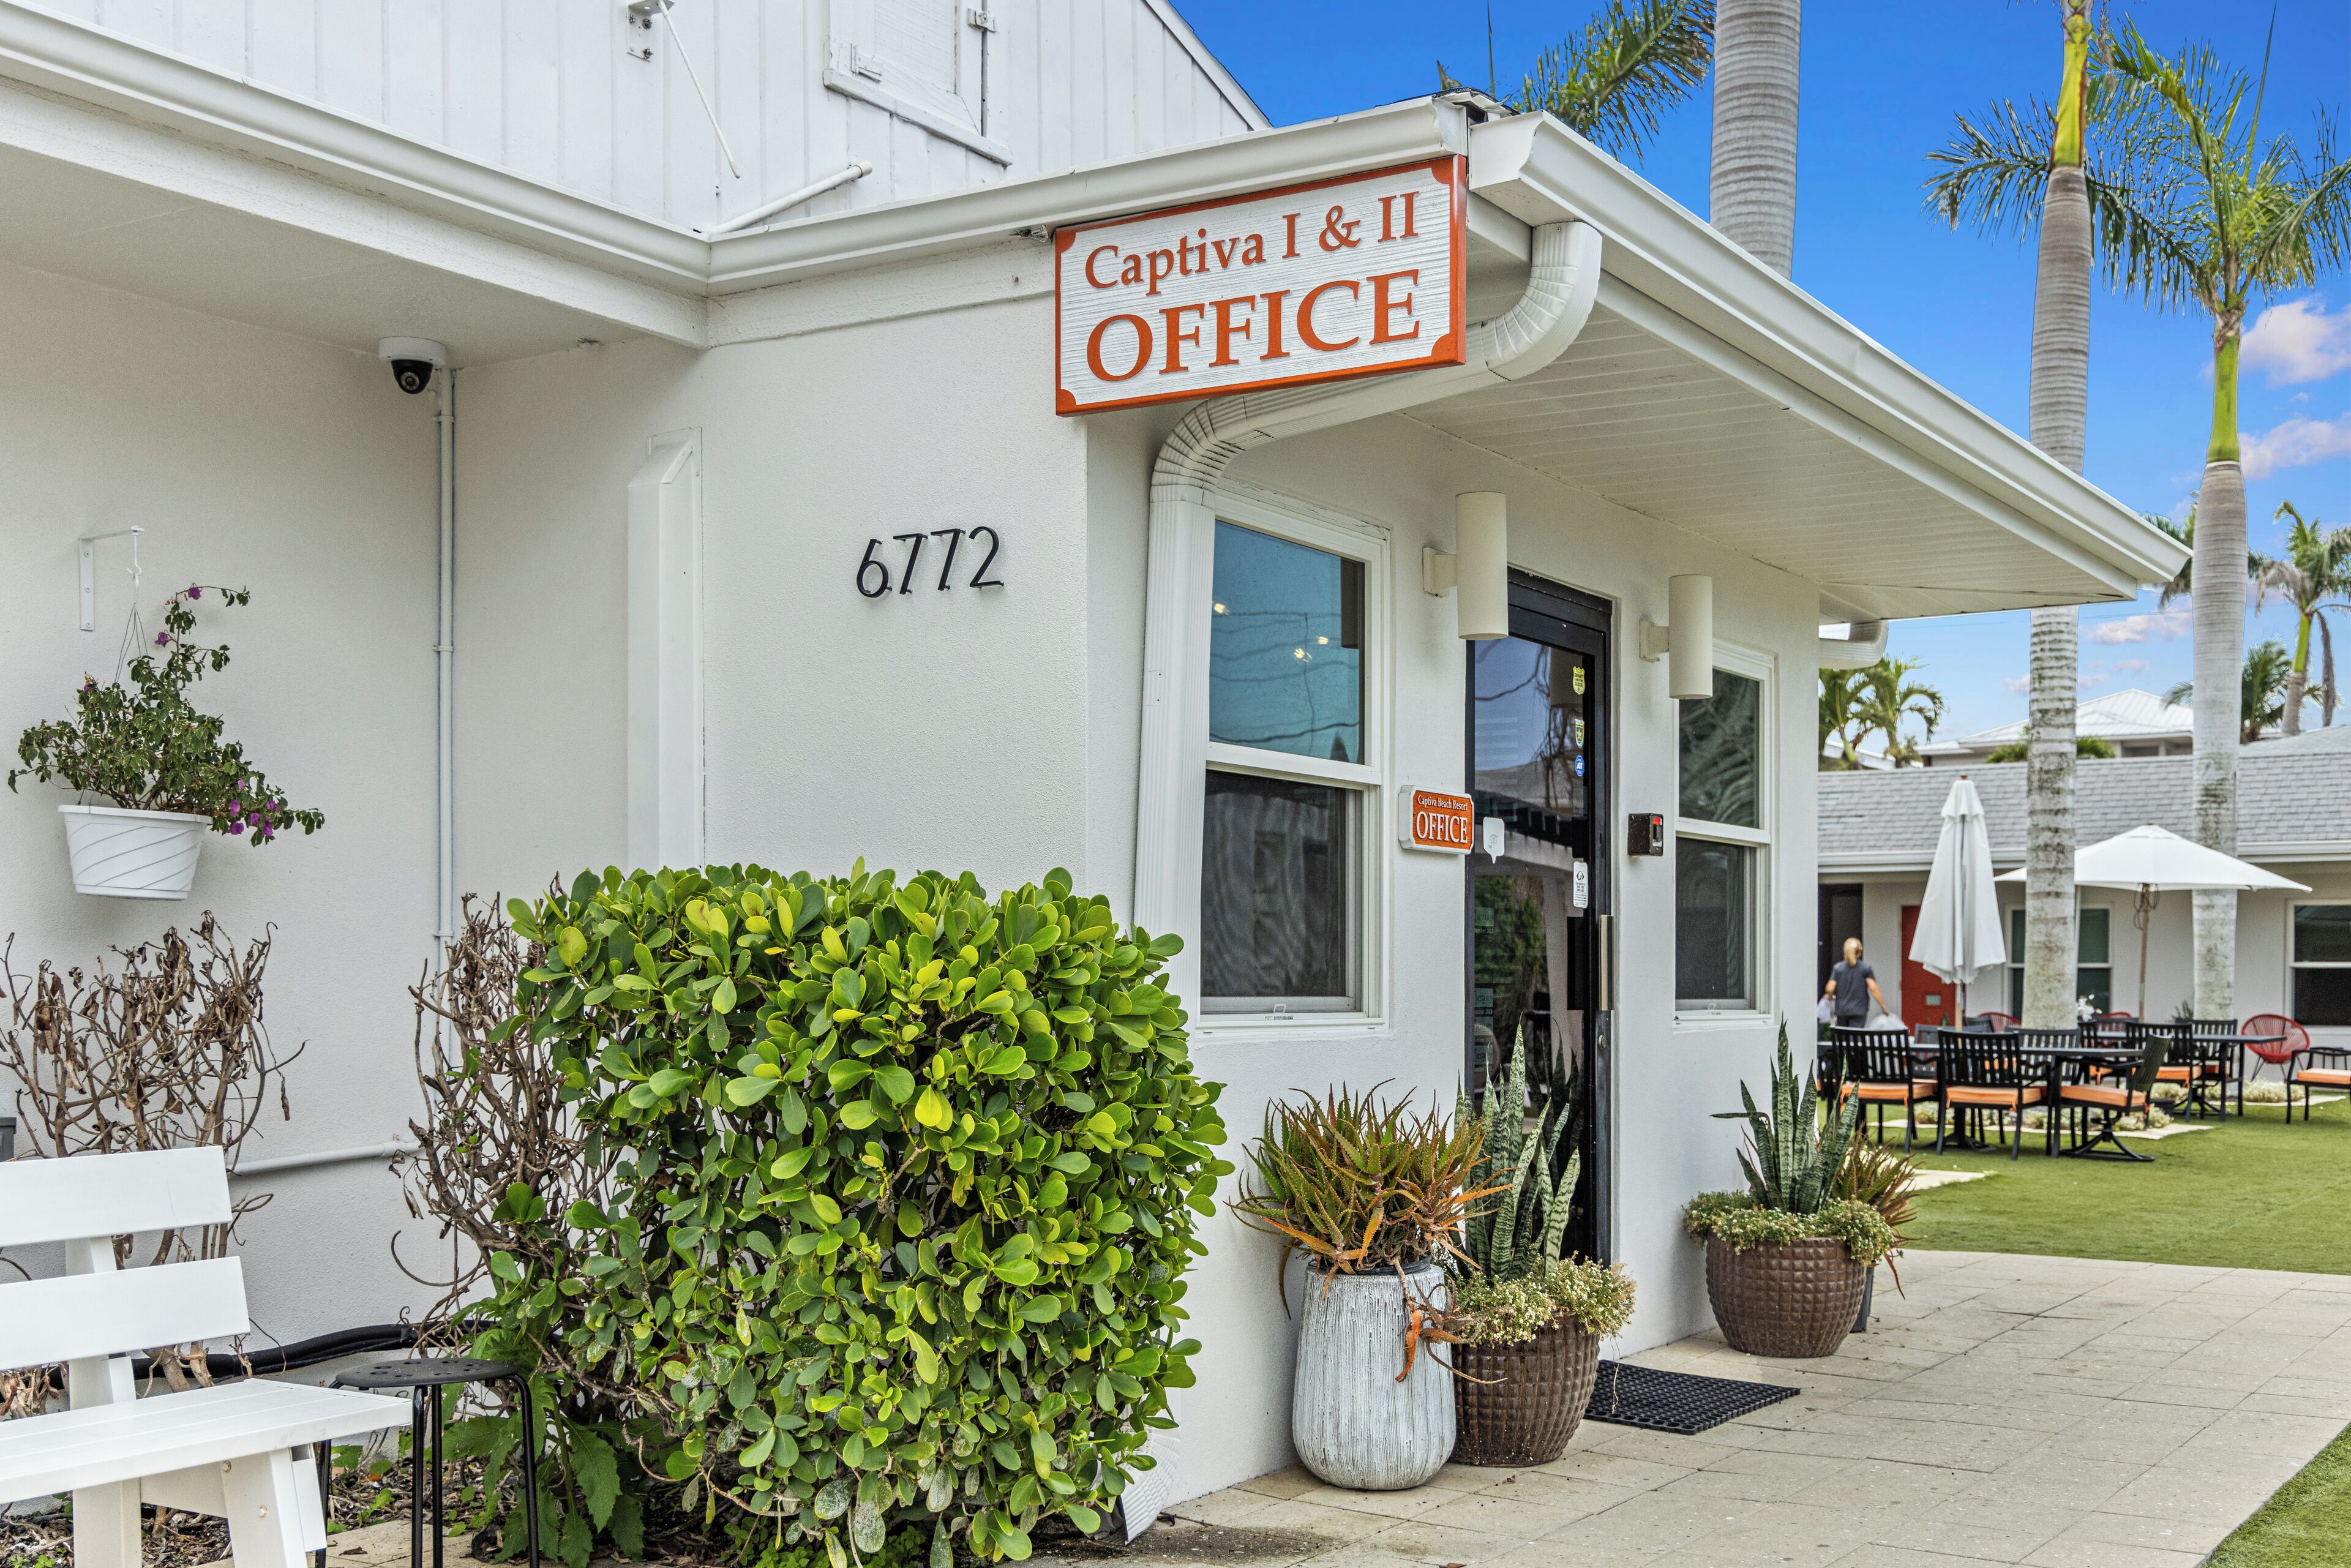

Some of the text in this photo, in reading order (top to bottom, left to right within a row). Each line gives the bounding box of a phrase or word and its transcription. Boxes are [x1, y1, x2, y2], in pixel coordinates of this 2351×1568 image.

[1086, 191, 1419, 296] Captiva I & II
[1087, 269, 1420, 381] OFFICE
[857, 526, 1002, 599] 6772
[1416, 811, 1468, 844] OFFICE
[1418, 795, 1468, 811] Captiva Beach Resort
